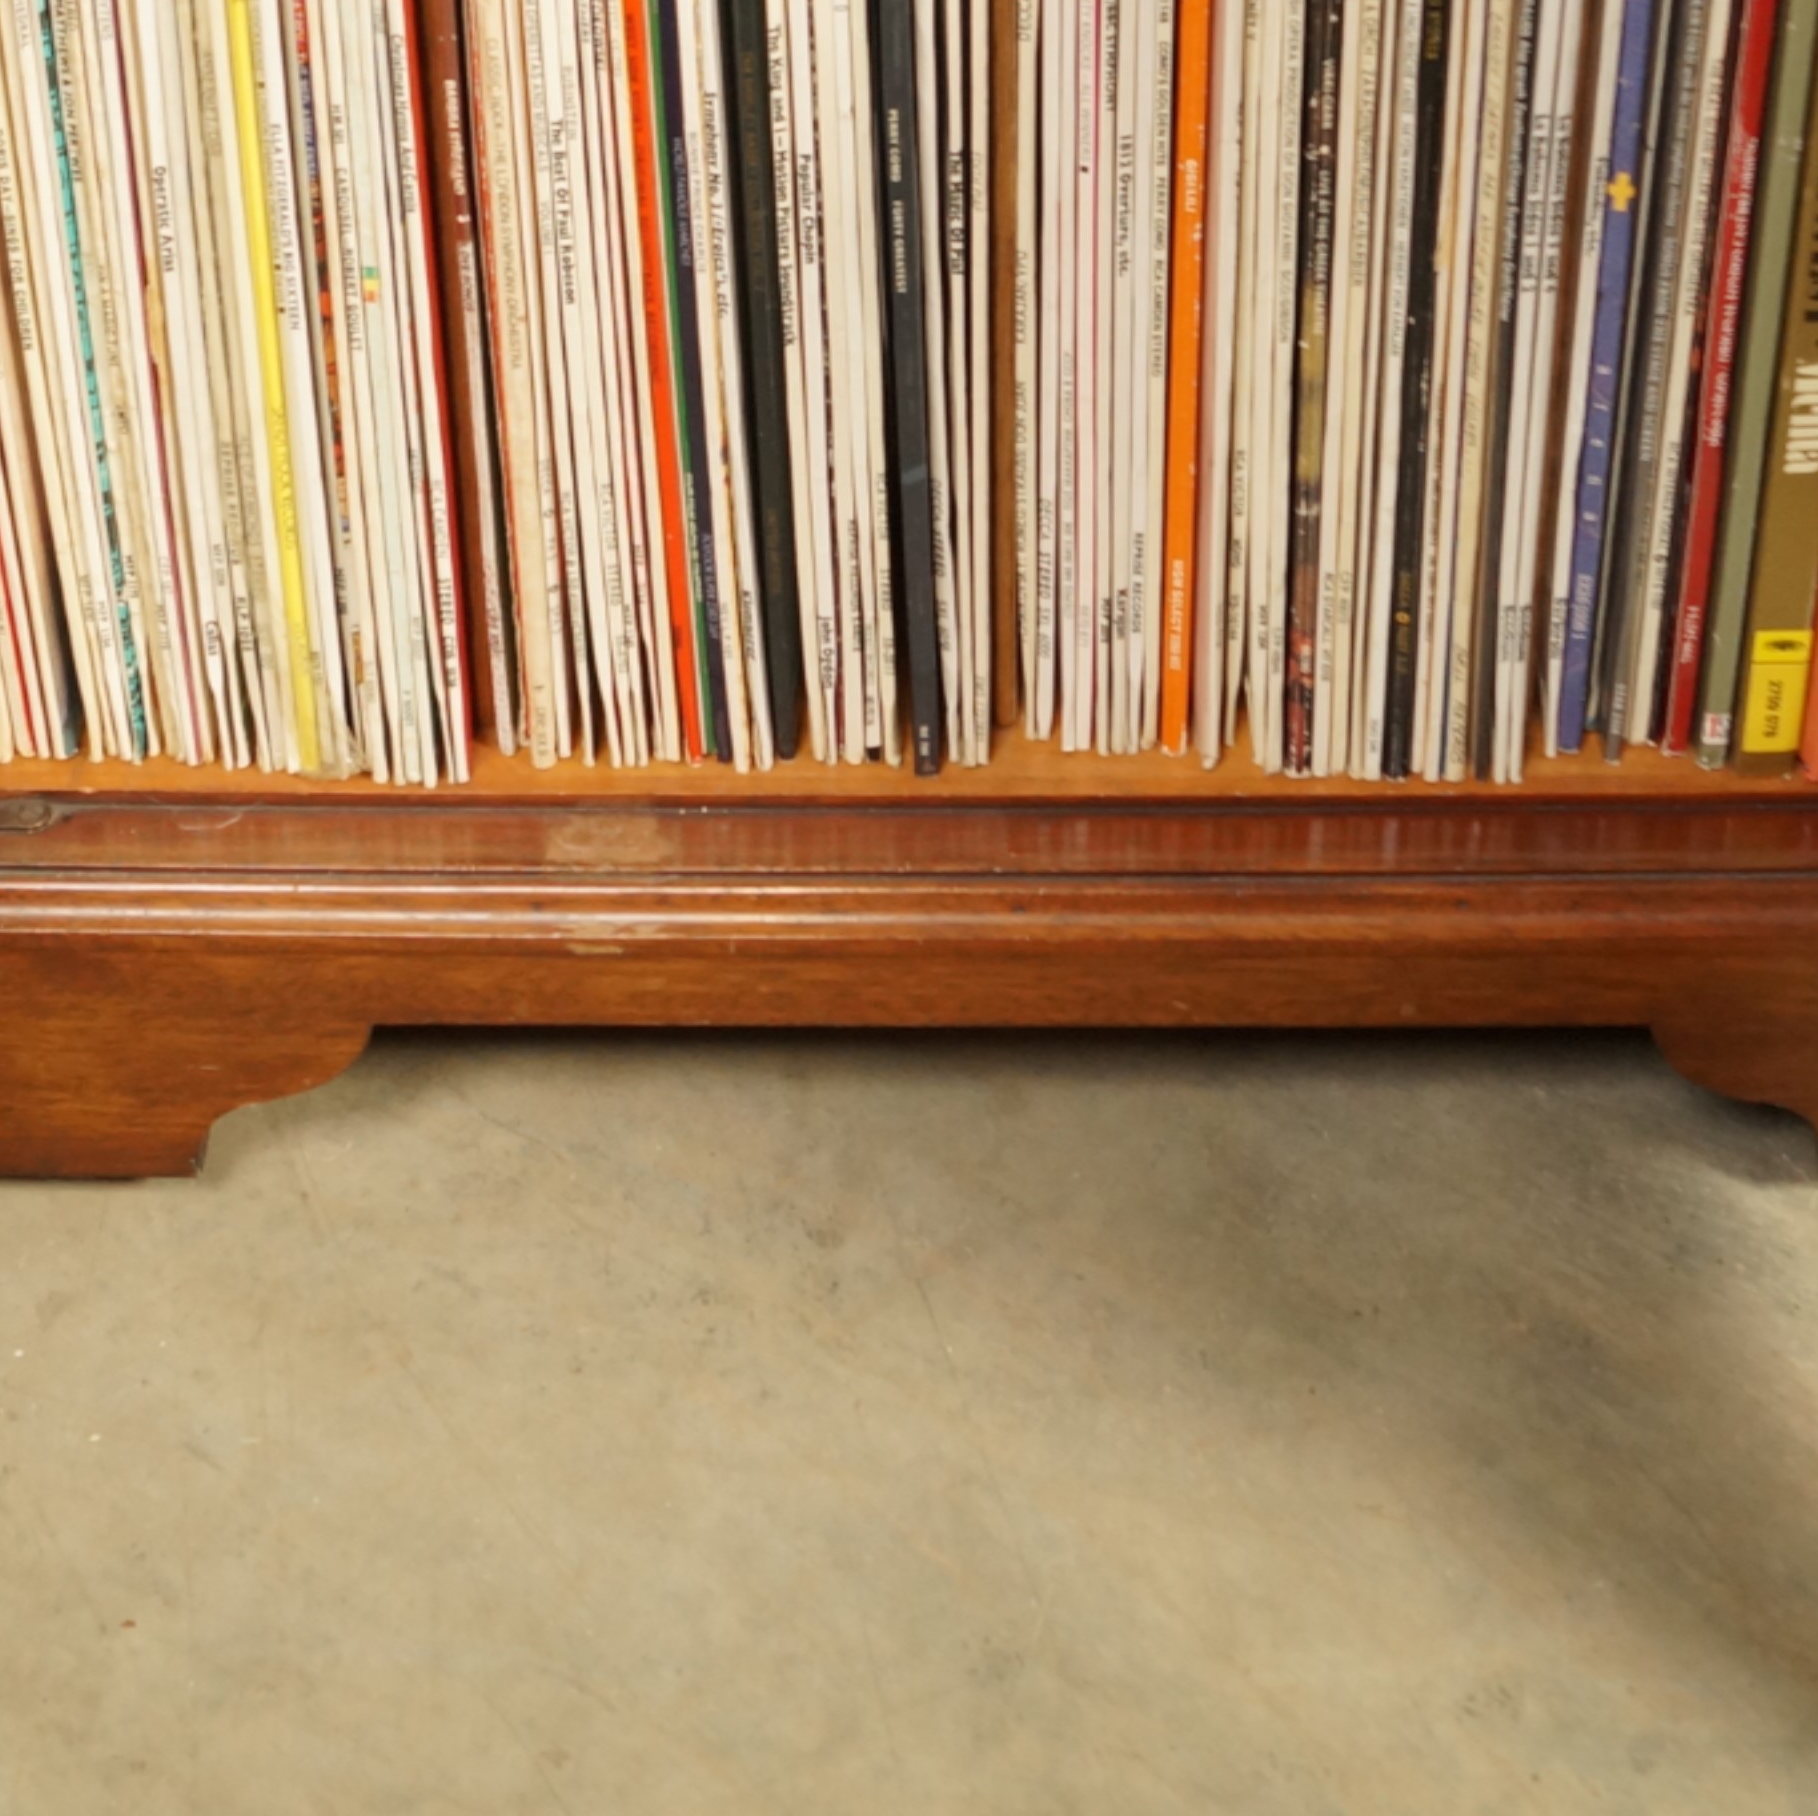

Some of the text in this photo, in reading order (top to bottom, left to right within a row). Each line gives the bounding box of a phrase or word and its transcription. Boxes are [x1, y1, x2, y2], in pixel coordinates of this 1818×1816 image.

[767, 26, 782, 53] The
[768, 58, 783, 91] King
[1157, 42, 1169, 85] COMO'S
[389, 33, 417, 213] Christmas Hymns And Carols
[701, 91, 719, 167] Symphony
[771, 98, 786, 123] and
[1156, 90, 1168, 137] GOLDEN
[269, 124, 285, 156] ELLA
[1119, 135, 1132, 169] 1812
[1156, 140, 1168, 166] HITS
[775, 150, 790, 203] Motion
[1155, 177, 1167, 214] PERRY
[153, 166, 176, 273] Operatic Arias
[550, 118, 577, 305] The Best Of Paul Robeson
[798, 154, 816, 264] Popular Chopin
[948, 150, 964, 275] The Magic Of Piaf
[1115, 174, 1132, 246] Overture,
[777, 208, 792, 259] Picture
[1154, 218, 1166, 251] COMO
[9, 258, 27, 285] FOR
[280, 253, 296, 275] BIG
[893, 239, 908, 293] GREATEST
[1154, 259, 1166, 282] RCA
[15, 289, 34, 351] CHILDREN
[283, 278, 301, 331] SIXTEEN
[779, 265, 796, 345] Soundtrack
[1153, 285, 1165, 332] CAMDEN
[1151, 335, 1163, 377] STEREO
[1038, 499, 1052, 541] DECCA
[1037, 552, 1051, 599] STEREO
[1130, 533, 1145, 633] REPRISE RECORDS
[1112, 588, 1127, 640] Karajan
